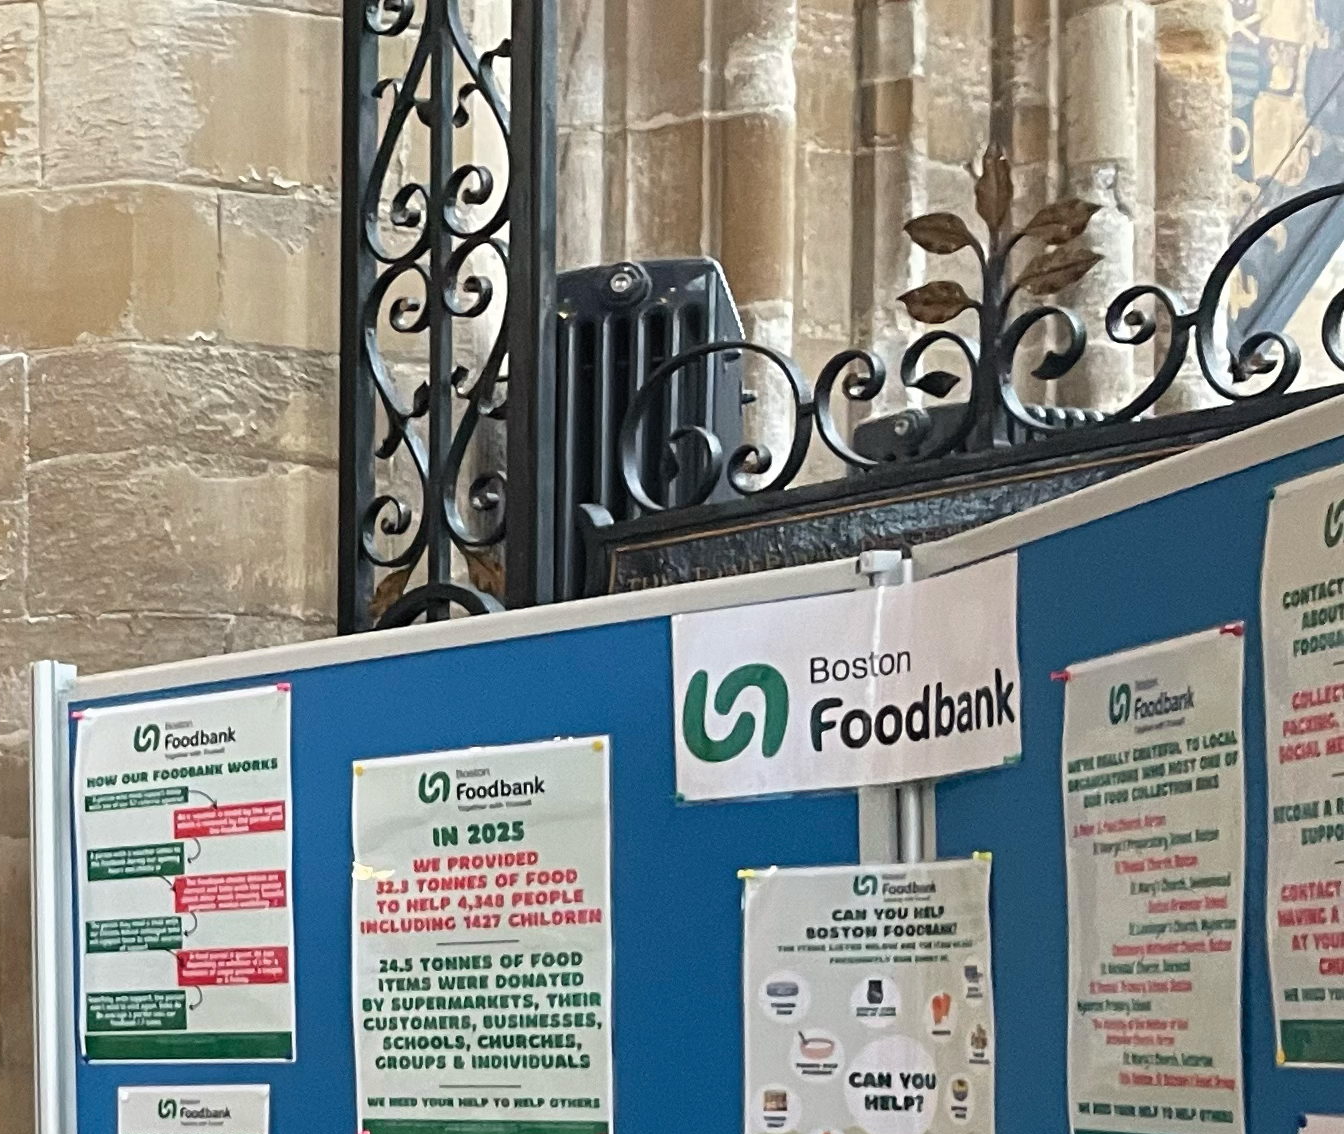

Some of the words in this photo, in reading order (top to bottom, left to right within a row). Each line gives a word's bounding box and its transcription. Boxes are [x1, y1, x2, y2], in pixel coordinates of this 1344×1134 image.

[1283, 577, 1344, 609] CONTACT
[1302, 603, 1344, 630] ABOUT
[810, 650, 911, 684] Boston
[1135, 686, 1194, 720] Foodbank
[1293, 683, 1344, 709] COLLEC
[811, 668, 1015, 751] Foodbank
[165, 727, 236, 749] Foodbank
[1186, 736, 1200, 751] TO
[1203, 730, 1238, 748] LOCAL
[87, 775, 118, 788] HOW
[122, 771, 148, 784] OUR
[153, 764, 223, 780] FOODBANK
[228, 758, 278, 774] WORKS
[1168, 758, 1196, 774] HOST
[1225, 751, 1238, 766] OF
[457, 776, 545, 800] Foodbank
[1132, 780, 1193, 801] COLLECTION
[1324, 799, 1332, 816] A
[433, 826, 458, 846] IN
[467, 821, 525, 844] 2025
[413, 858, 440, 872] WE
[448, 851, 539, 870] PROVIDED
[417, 875, 487, 892] TONNES
[495, 873, 519, 887] OF
[526, 869, 578, 885] FOOD
[882, 882, 935, 894] Foodbank
[1281, 880, 1341, 902] CONTACT
[377, 900, 400, 914] TO
[407, 896, 451, 912] HELP
[512, 889, 584, 906] PEOPLE
[360, 917, 456, 934] INCLUDING
[464, 914, 501, 929] 1427
[508, 909, 602, 927] CHILDREN
[832, 910, 866, 921] CAN
[874, 908, 908, 920] YOU
[914, 906, 944, 919] HELP
[1331, 904, 1339, 923] A
[806, 925, 876, 939] BOSTON
[884, 923, 957, 936] FOODBANK?
[1292, 934, 1308, 951] AT
[380, 958, 413, 973] 24.5
[420, 955, 492, 971] TONNES
[500, 954, 524, 969] OF
[531, 951, 583, 968] FOOD
[378, 977, 431, 992] ITEMS
[438, 975, 489, 990] WERE
[496, 972, 584, 989] DONATED
[362, 998, 384, 1012] BY
[391, 994, 540, 1011] SUPERMARKETS,
[546, 992, 602, 1007] THEIR
[363, 1015, 477, 1032] CUSTOMERS,
[483, 1012, 603, 1030] BUSINESSES,
[383, 1035, 471, 1052] SCHOOLS,
[478, 1034, 582, 1050] CHURCHES,
[375, 1056, 446, 1070] GROUPS
[454, 1056, 465, 1069] &
[472, 1054, 591, 1069] INDIVIDUALS
[849, 1073, 891, 1088] CAN
[900, 1073, 936, 1089] YOU
[180, 1107, 231, 1119] Foodbank
[368, 1097, 385, 1108] WE
[389, 1097, 417, 1107] NEED
[422, 1097, 454, 1107] YOUR
[459, 1097, 488, 1108] HELP
[493, 1097, 511, 1108] TO
[514, 1097, 545, 1108] HELP
[550, 1097, 600, 1108] OTHERS
[865, 1095, 923, 1112] HELP?
